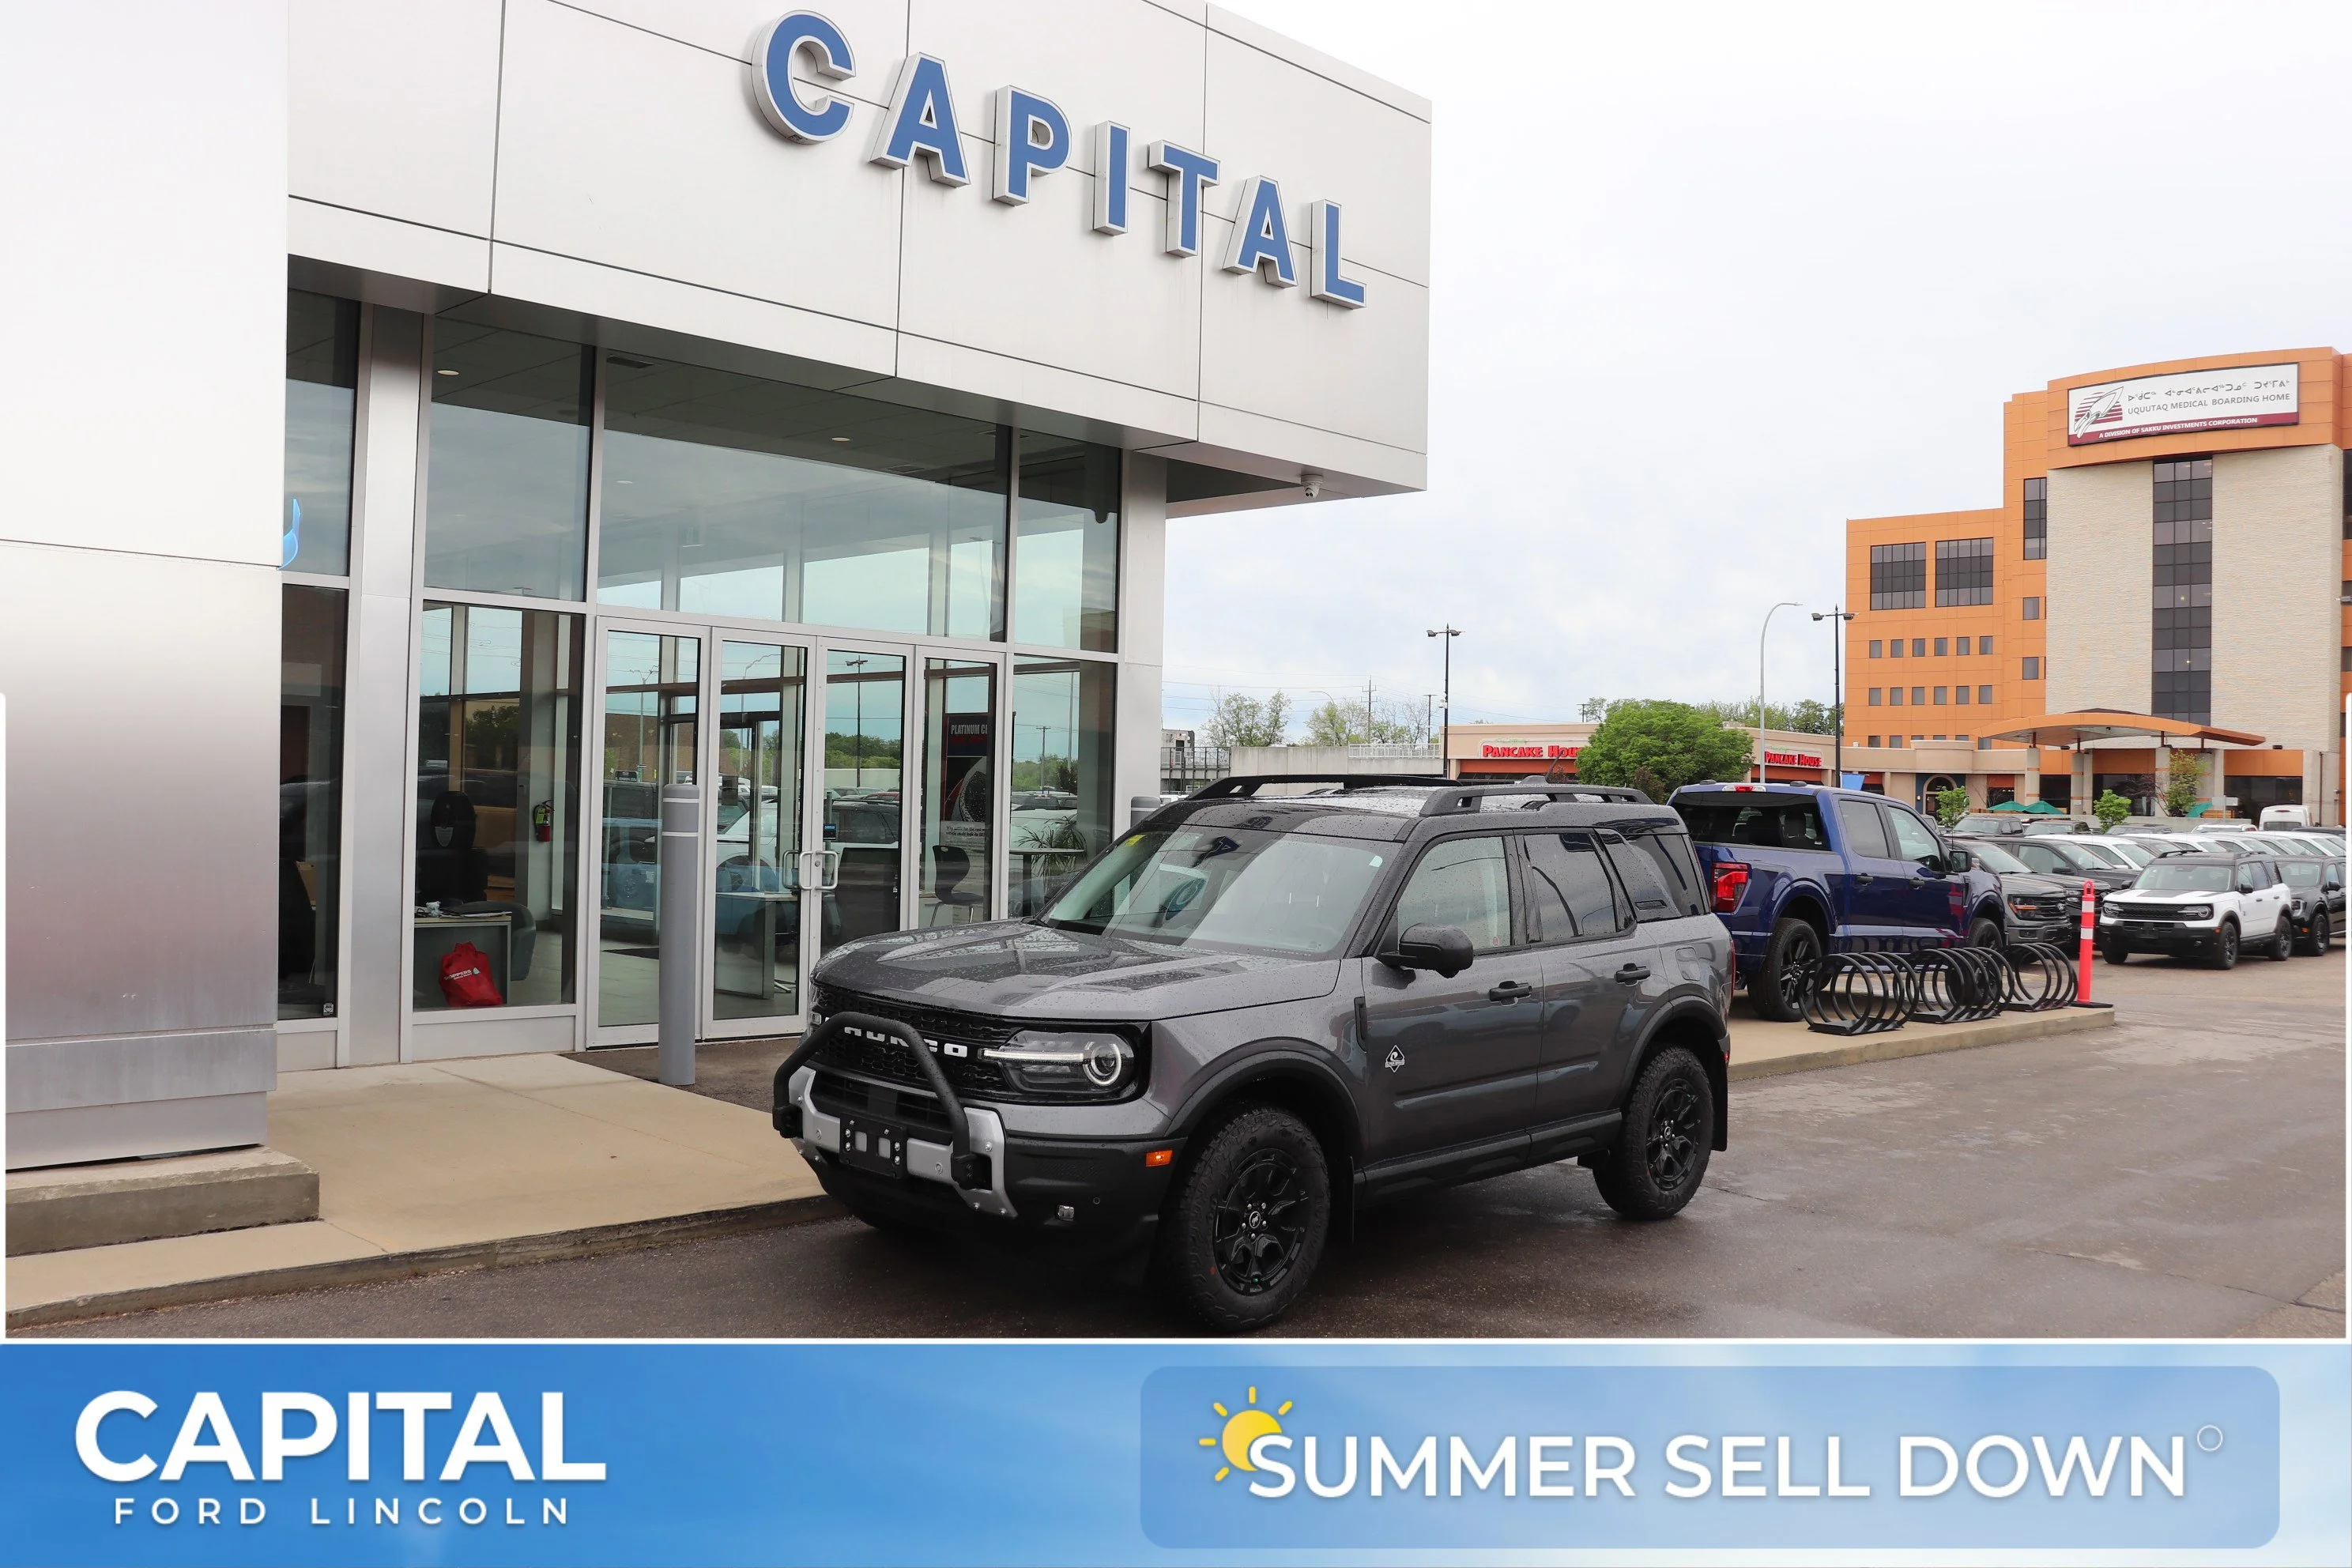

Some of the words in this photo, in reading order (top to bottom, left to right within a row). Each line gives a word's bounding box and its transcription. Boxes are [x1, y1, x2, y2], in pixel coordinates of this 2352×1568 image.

[751, 9, 1367, 311] CAPITAL
[2128, 404, 2168, 415] UQUUTAQ
[2170, 400, 2208, 409] MEDICAL
[2211, 395, 2260, 405] BOARDING
[2262, 393, 2290, 402] HOME
[2104, 428, 2131, 438] DIVISION
[2141, 424, 2162, 433] SAKKU
[2162, 420, 2207, 431] INVESTMENTS
[2208, 417, 2258, 427] CORPORATION
[951, 724, 980, 735] PLATINUM
[1483, 744, 1543, 758] PANCAKE
[1547, 744, 1583, 758] HOU
[1764, 751, 1798, 764] PANCAKE
[1798, 753, 1822, 767] HOUSE
